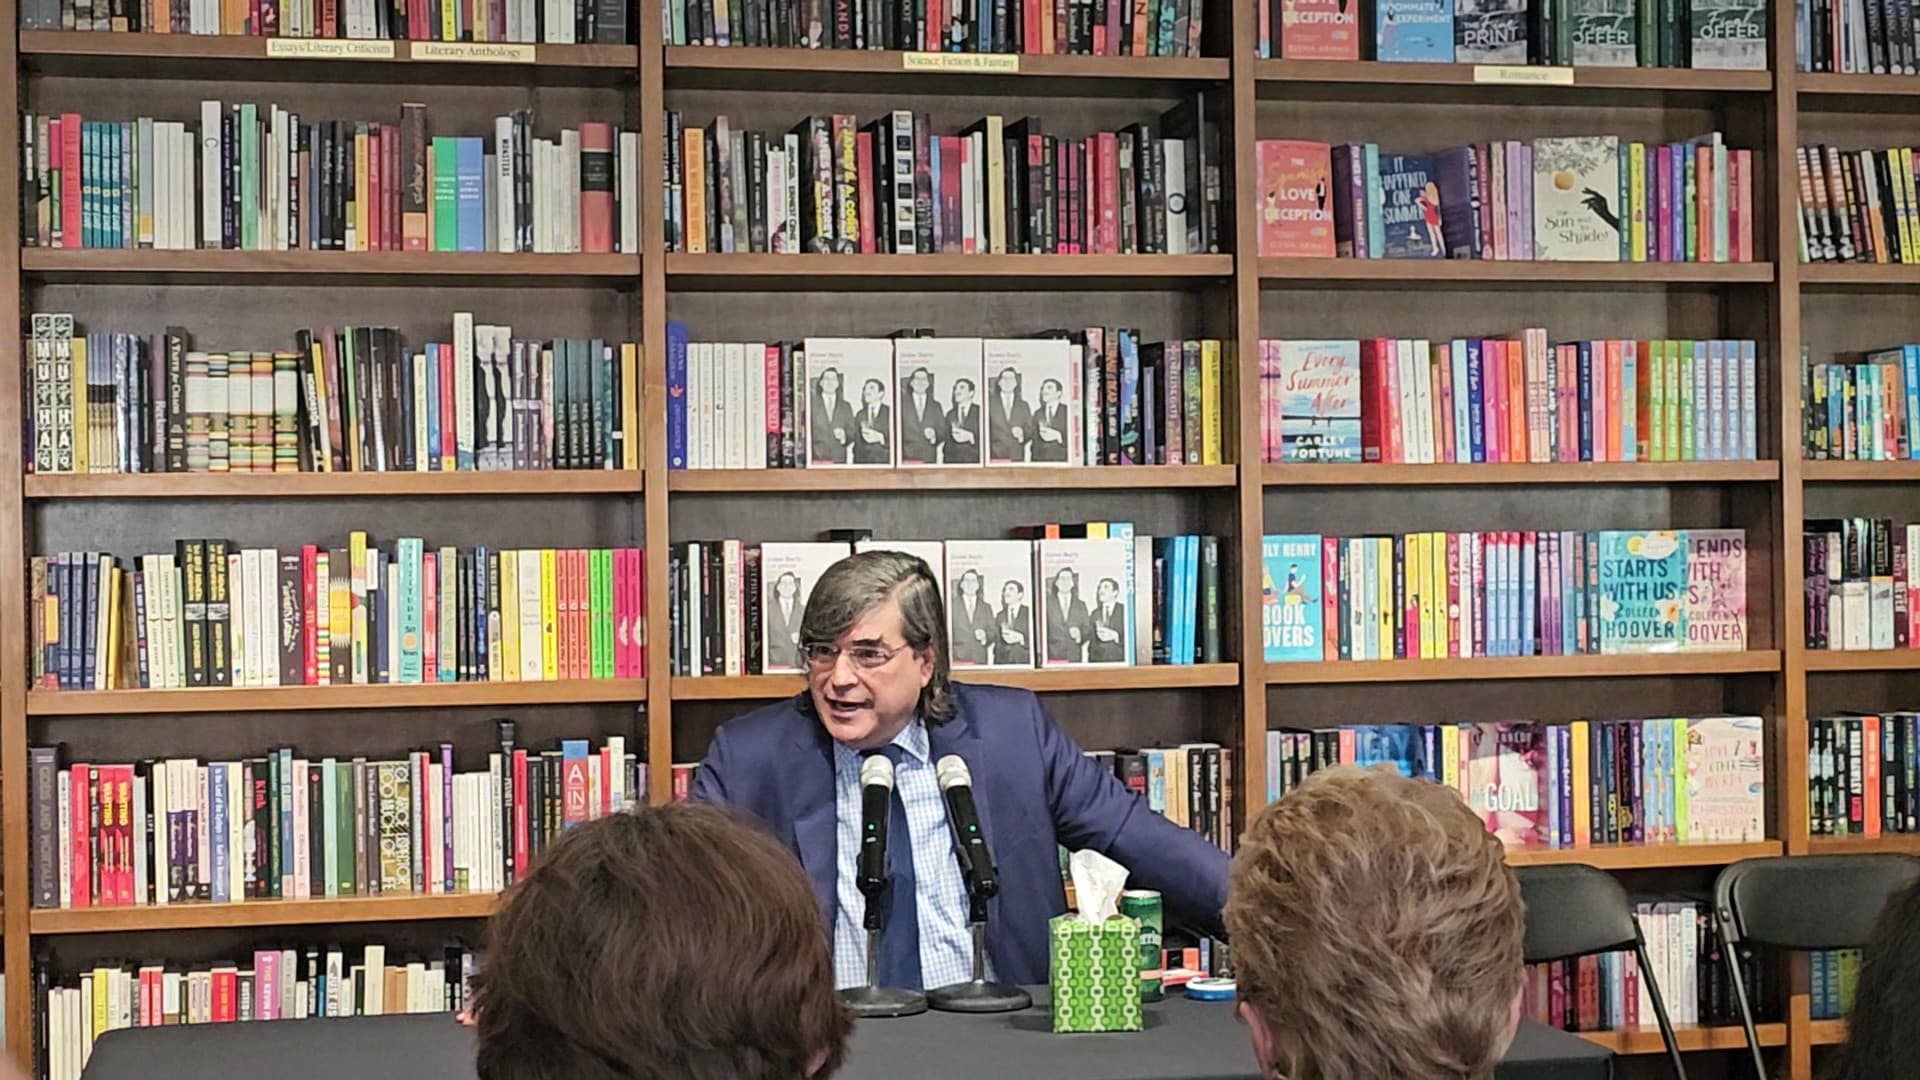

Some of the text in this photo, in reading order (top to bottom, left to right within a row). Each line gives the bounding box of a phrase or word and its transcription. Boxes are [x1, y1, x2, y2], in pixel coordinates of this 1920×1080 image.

[1464, 27, 1519, 46] PRINT
[1572, 30, 1629, 45] OFFER
[1700, 24, 1760, 39] OFFER
[424, 45, 521, 59] Literary Anthology
[1280, 189, 1315, 200] LOVE
[1265, 209, 1331, 222] DECEPTION
[1544, 217, 1575, 230] Sun
[1303, 351, 1346, 374] Every
[1286, 371, 1351, 392] Summer
[1311, 390, 1347, 414] After
[1291, 449, 1351, 459] FORTUNE
[1283, 543, 1316, 557] HENRY
[1697, 539, 1743, 558] ENDS
[1603, 559, 1668, 578] STARTS
[1604, 582, 1679, 600] WITH US
[1689, 585, 1699, 604] S
[1605, 621, 1675, 639] HOOVER
[1689, 624, 1741, 641] OOVER
[255, 779, 266, 808] Kink
[1485, 783, 1539, 812] GOAL
[103, 782, 113, 826] WANTING
[119, 782, 129, 826] WANTING
